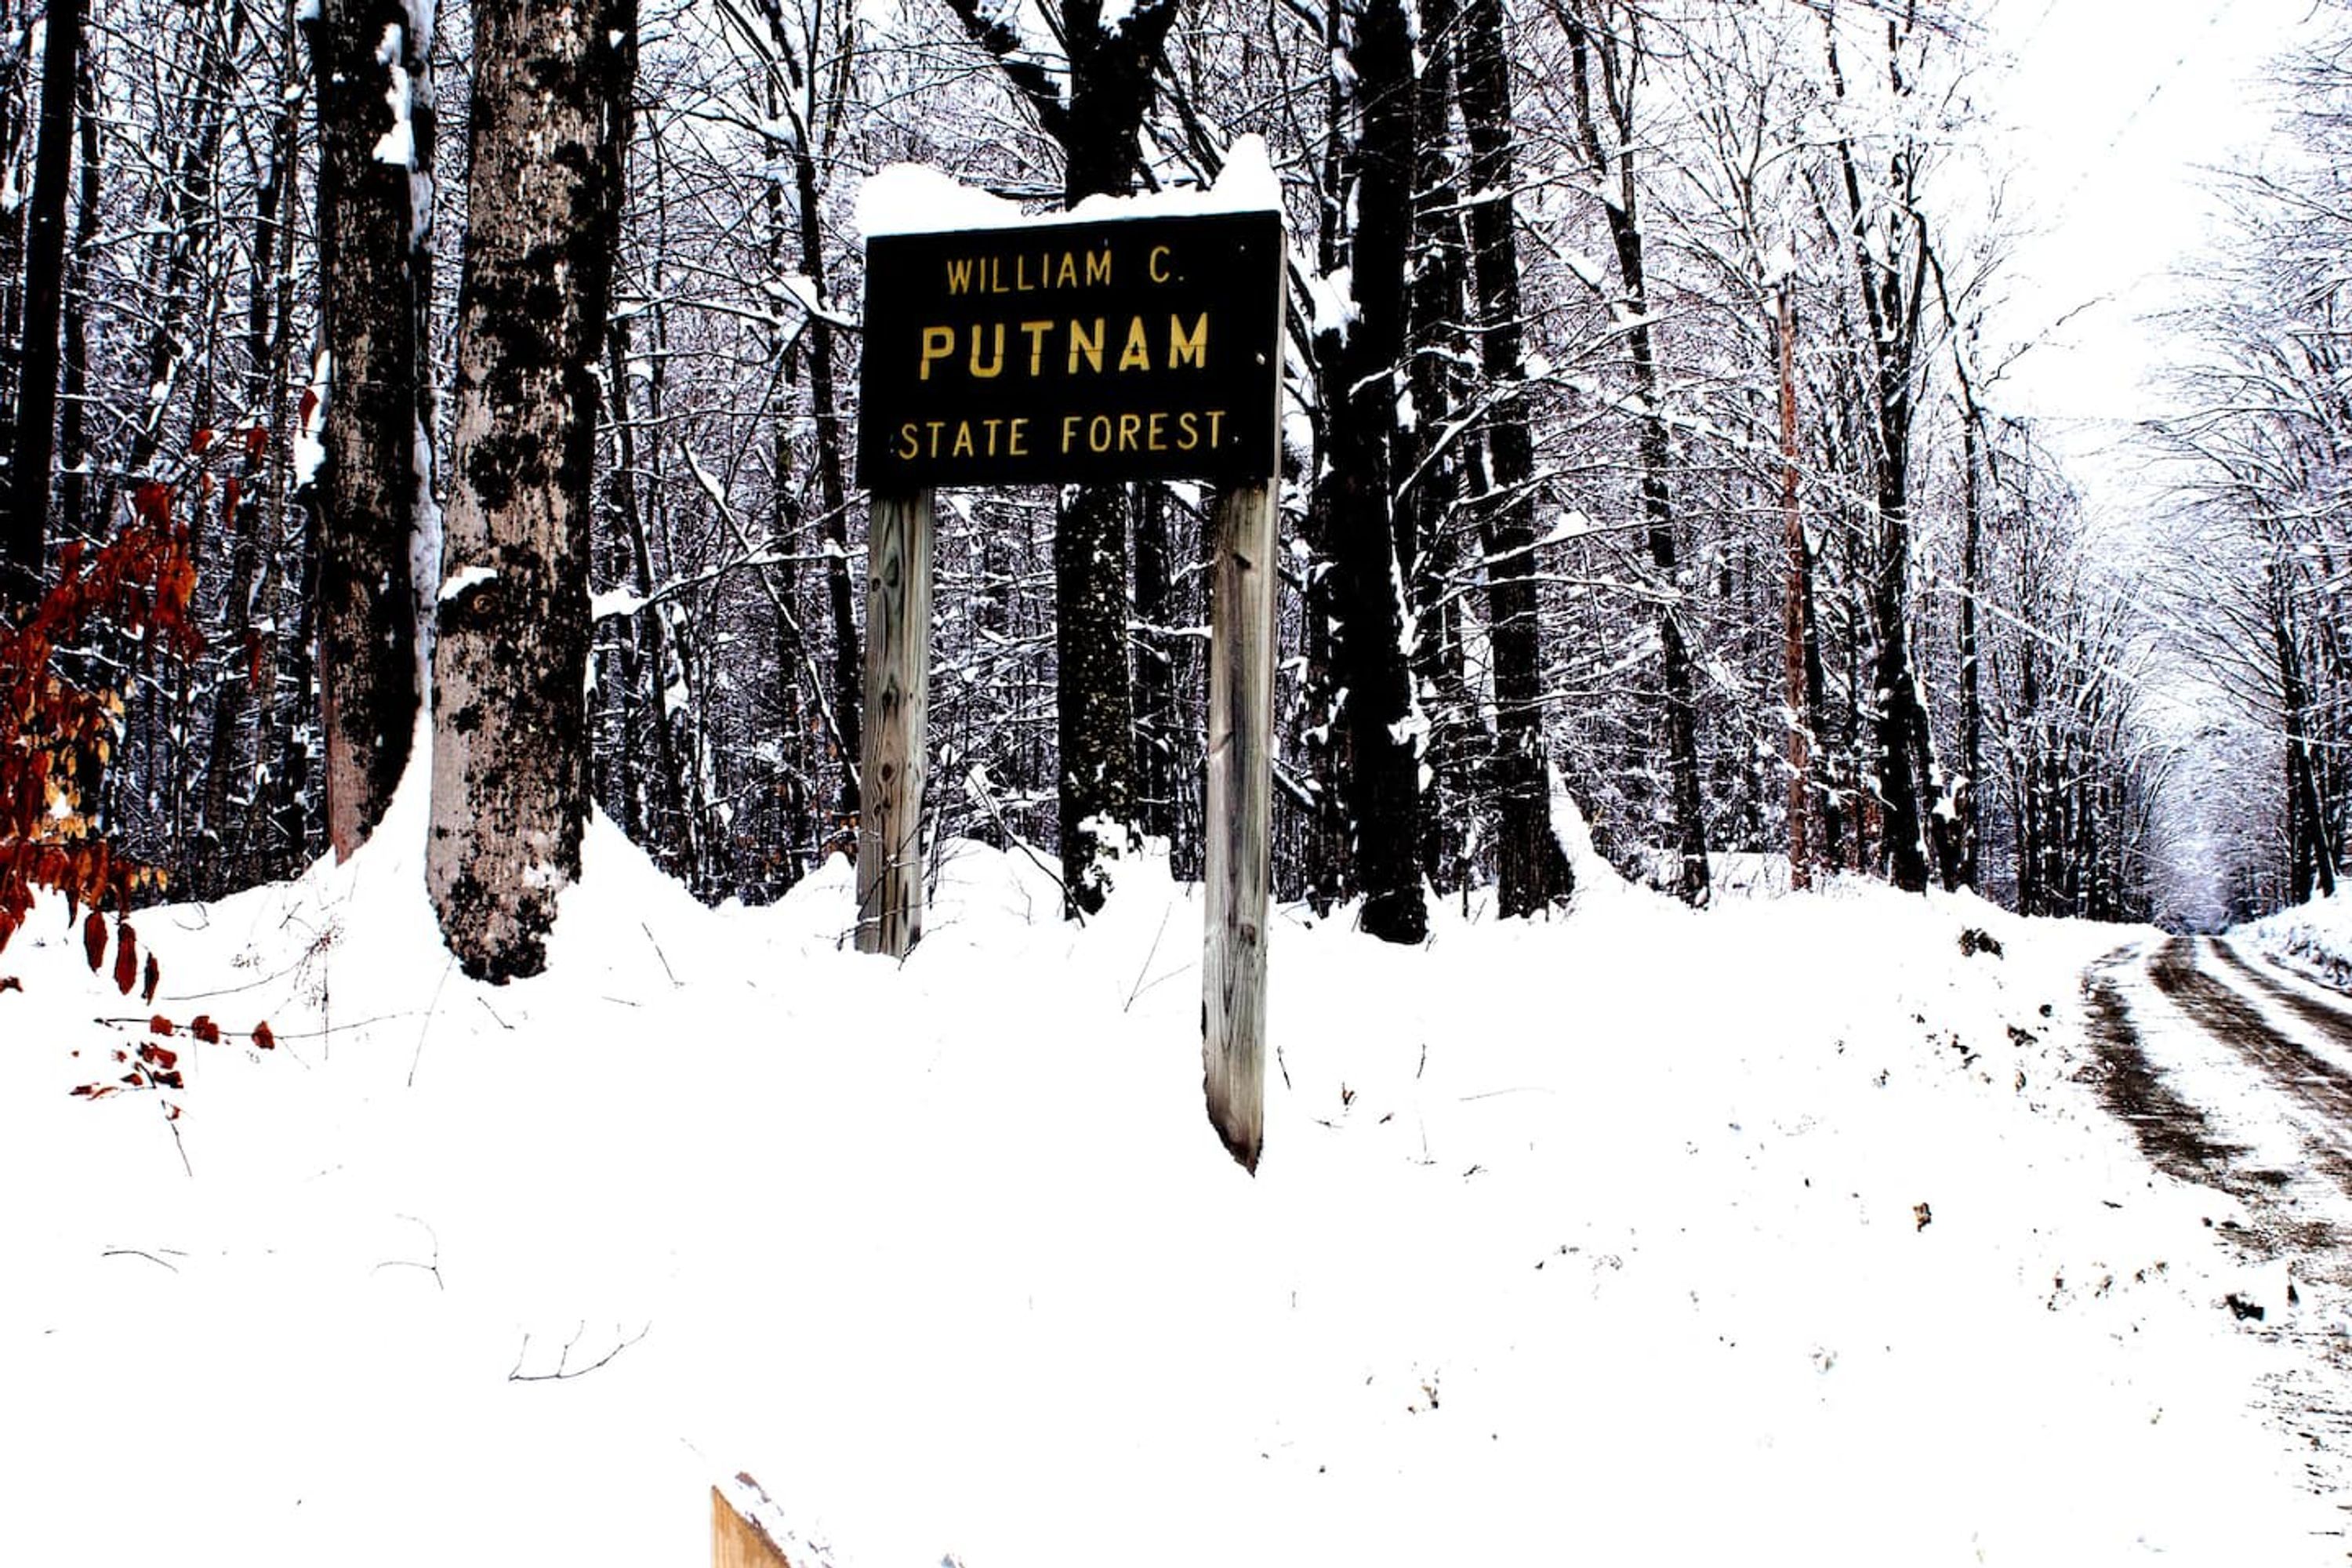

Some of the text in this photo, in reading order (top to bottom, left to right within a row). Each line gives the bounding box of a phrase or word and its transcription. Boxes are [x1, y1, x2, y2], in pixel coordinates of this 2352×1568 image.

[946, 249, 1112, 295] WILLIAM
[919, 312, 1208, 381] PUTNAM
[898, 410, 1225, 460] STATE FOREST
